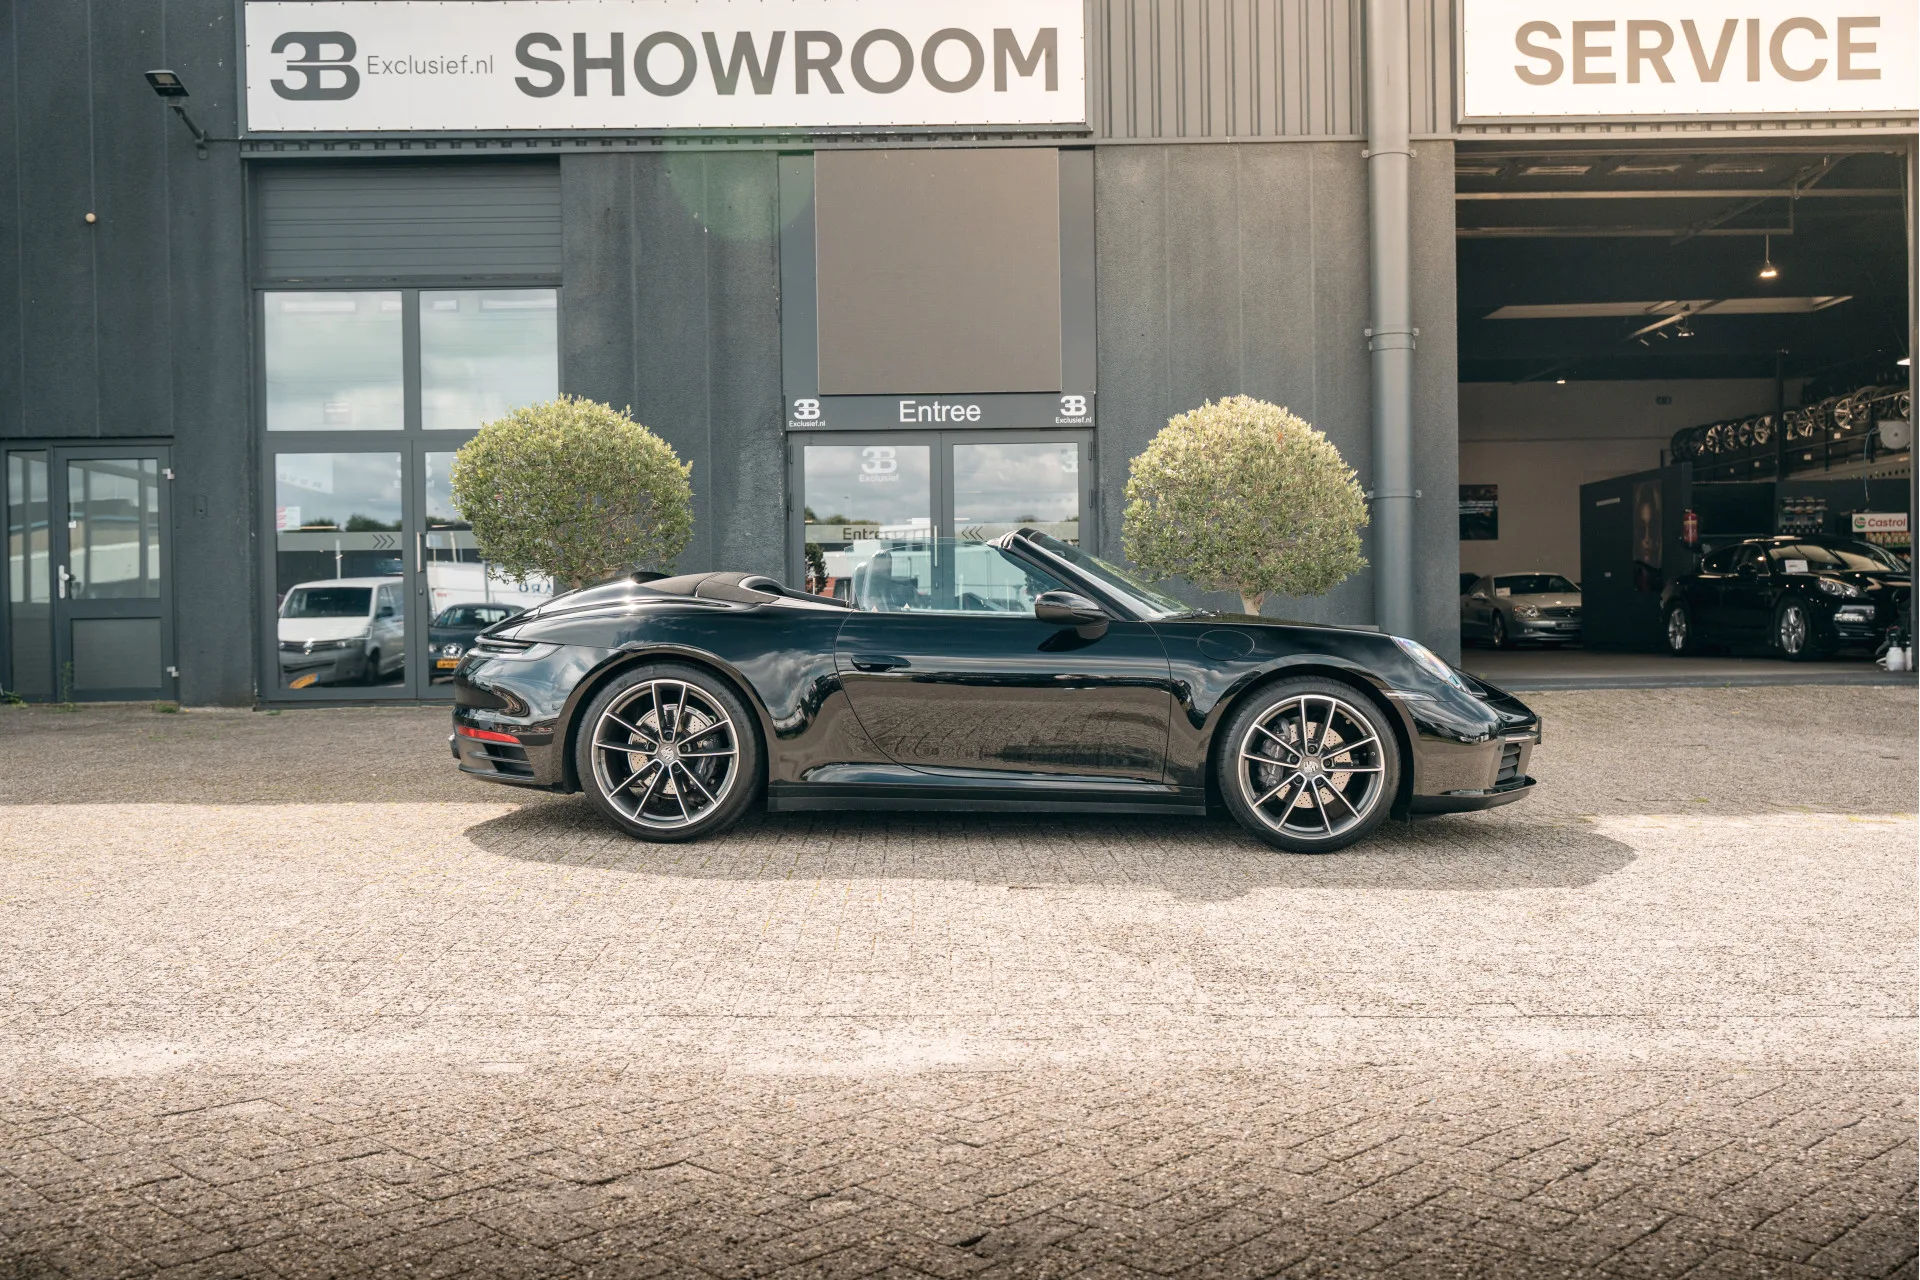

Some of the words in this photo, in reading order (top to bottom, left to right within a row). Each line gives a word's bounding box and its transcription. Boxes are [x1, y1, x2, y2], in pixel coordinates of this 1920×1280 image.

[1514, 16, 1882, 86] SERVICE
[367, 54, 494, 75] Exclusief.nl
[514, 27, 1059, 98] SHOWROOM
[899, 400, 981, 422] Entree
[788, 420, 826, 428] Exclusief.nl
[1055, 416, 1092, 424] Exclusief.nl
[1868, 518, 1906, 528] Castrol
